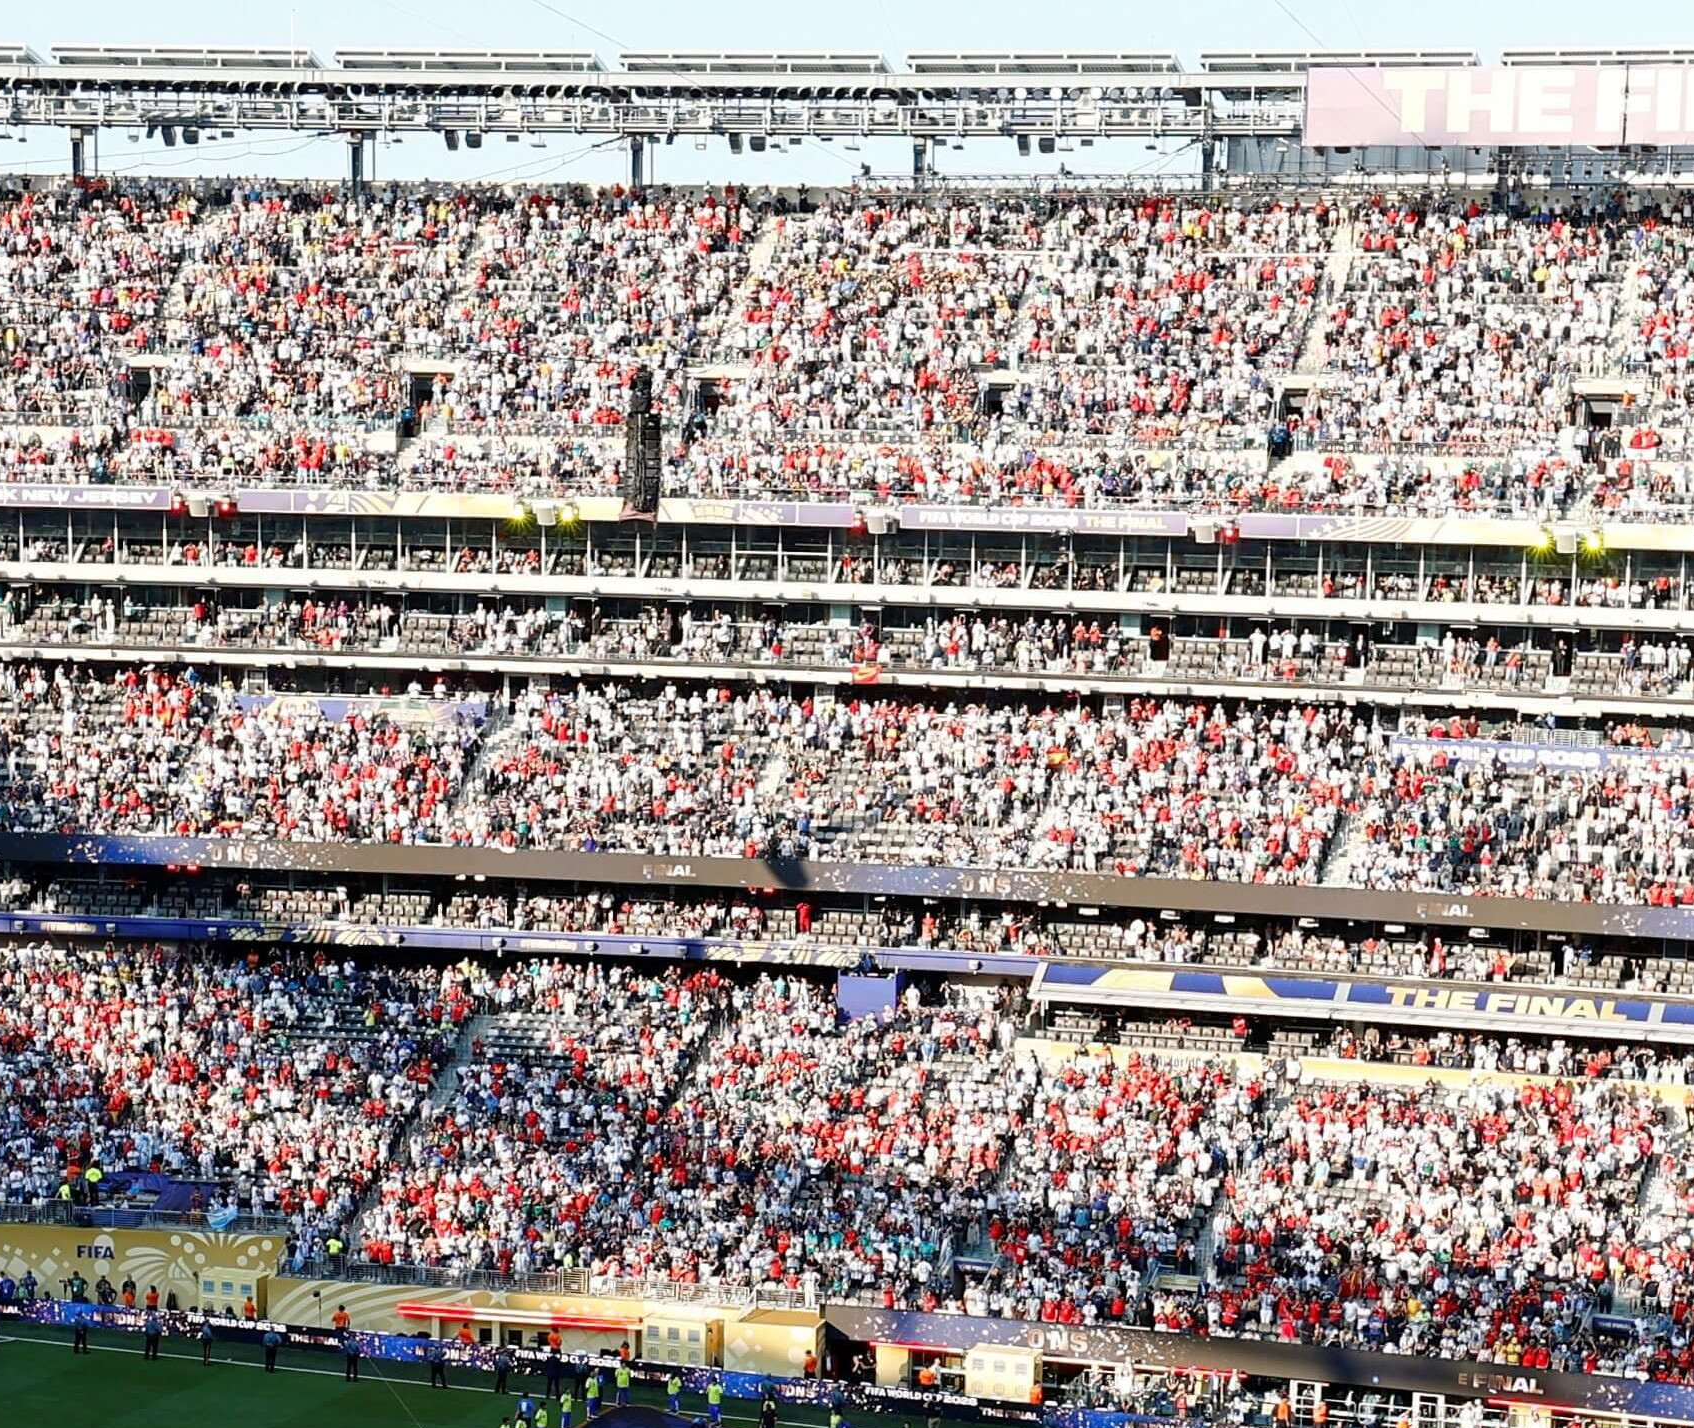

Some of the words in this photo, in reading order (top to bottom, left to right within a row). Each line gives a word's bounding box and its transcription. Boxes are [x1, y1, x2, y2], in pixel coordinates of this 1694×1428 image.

[1382, 70, 1589, 134] THE
[21, 490, 66, 501] NEW
[72, 491, 157, 503] JERSEY
[1083, 516, 1115, 528] THE
[1118, 517, 1166, 529] FINAL
[1385, 986, 1479, 1011] THE
[1485, 992, 1628, 1022] FINAL
[77, 1245, 115, 1259] FIFA
[1473, 1373, 1544, 1394] FINAL
[981, 1407, 1005, 1418] THE
